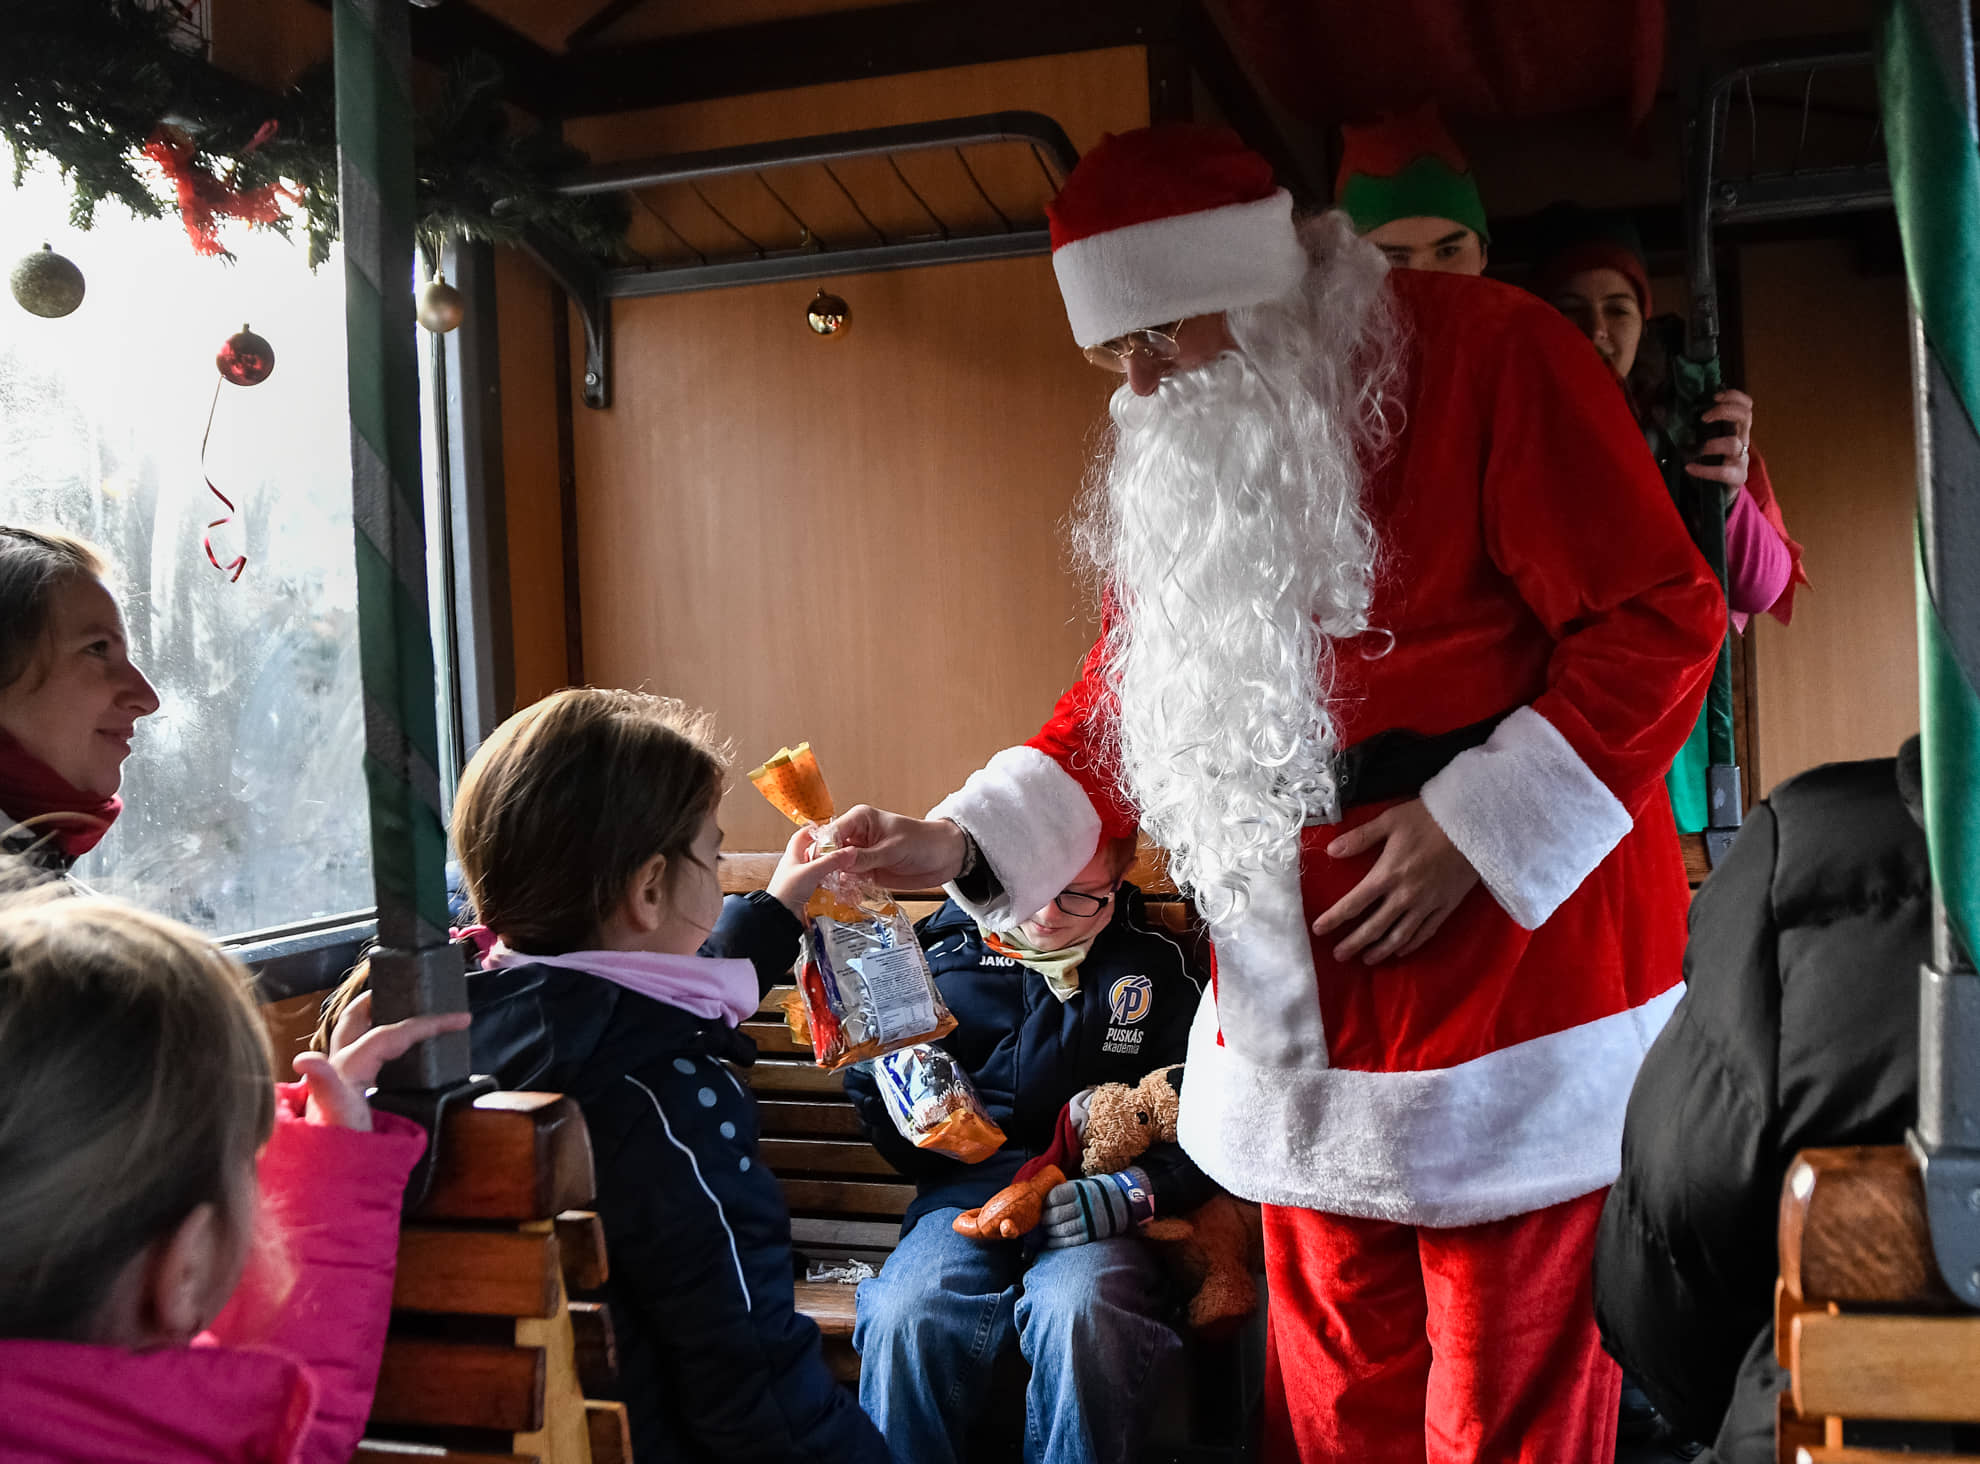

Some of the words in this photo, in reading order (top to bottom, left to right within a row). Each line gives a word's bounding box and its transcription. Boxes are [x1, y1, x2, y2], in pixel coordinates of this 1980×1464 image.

[979, 955, 1015, 967] JAKO
[1106, 1027, 1144, 1044] PUSKÁS
[1102, 1041, 1140, 1055] akadémia
